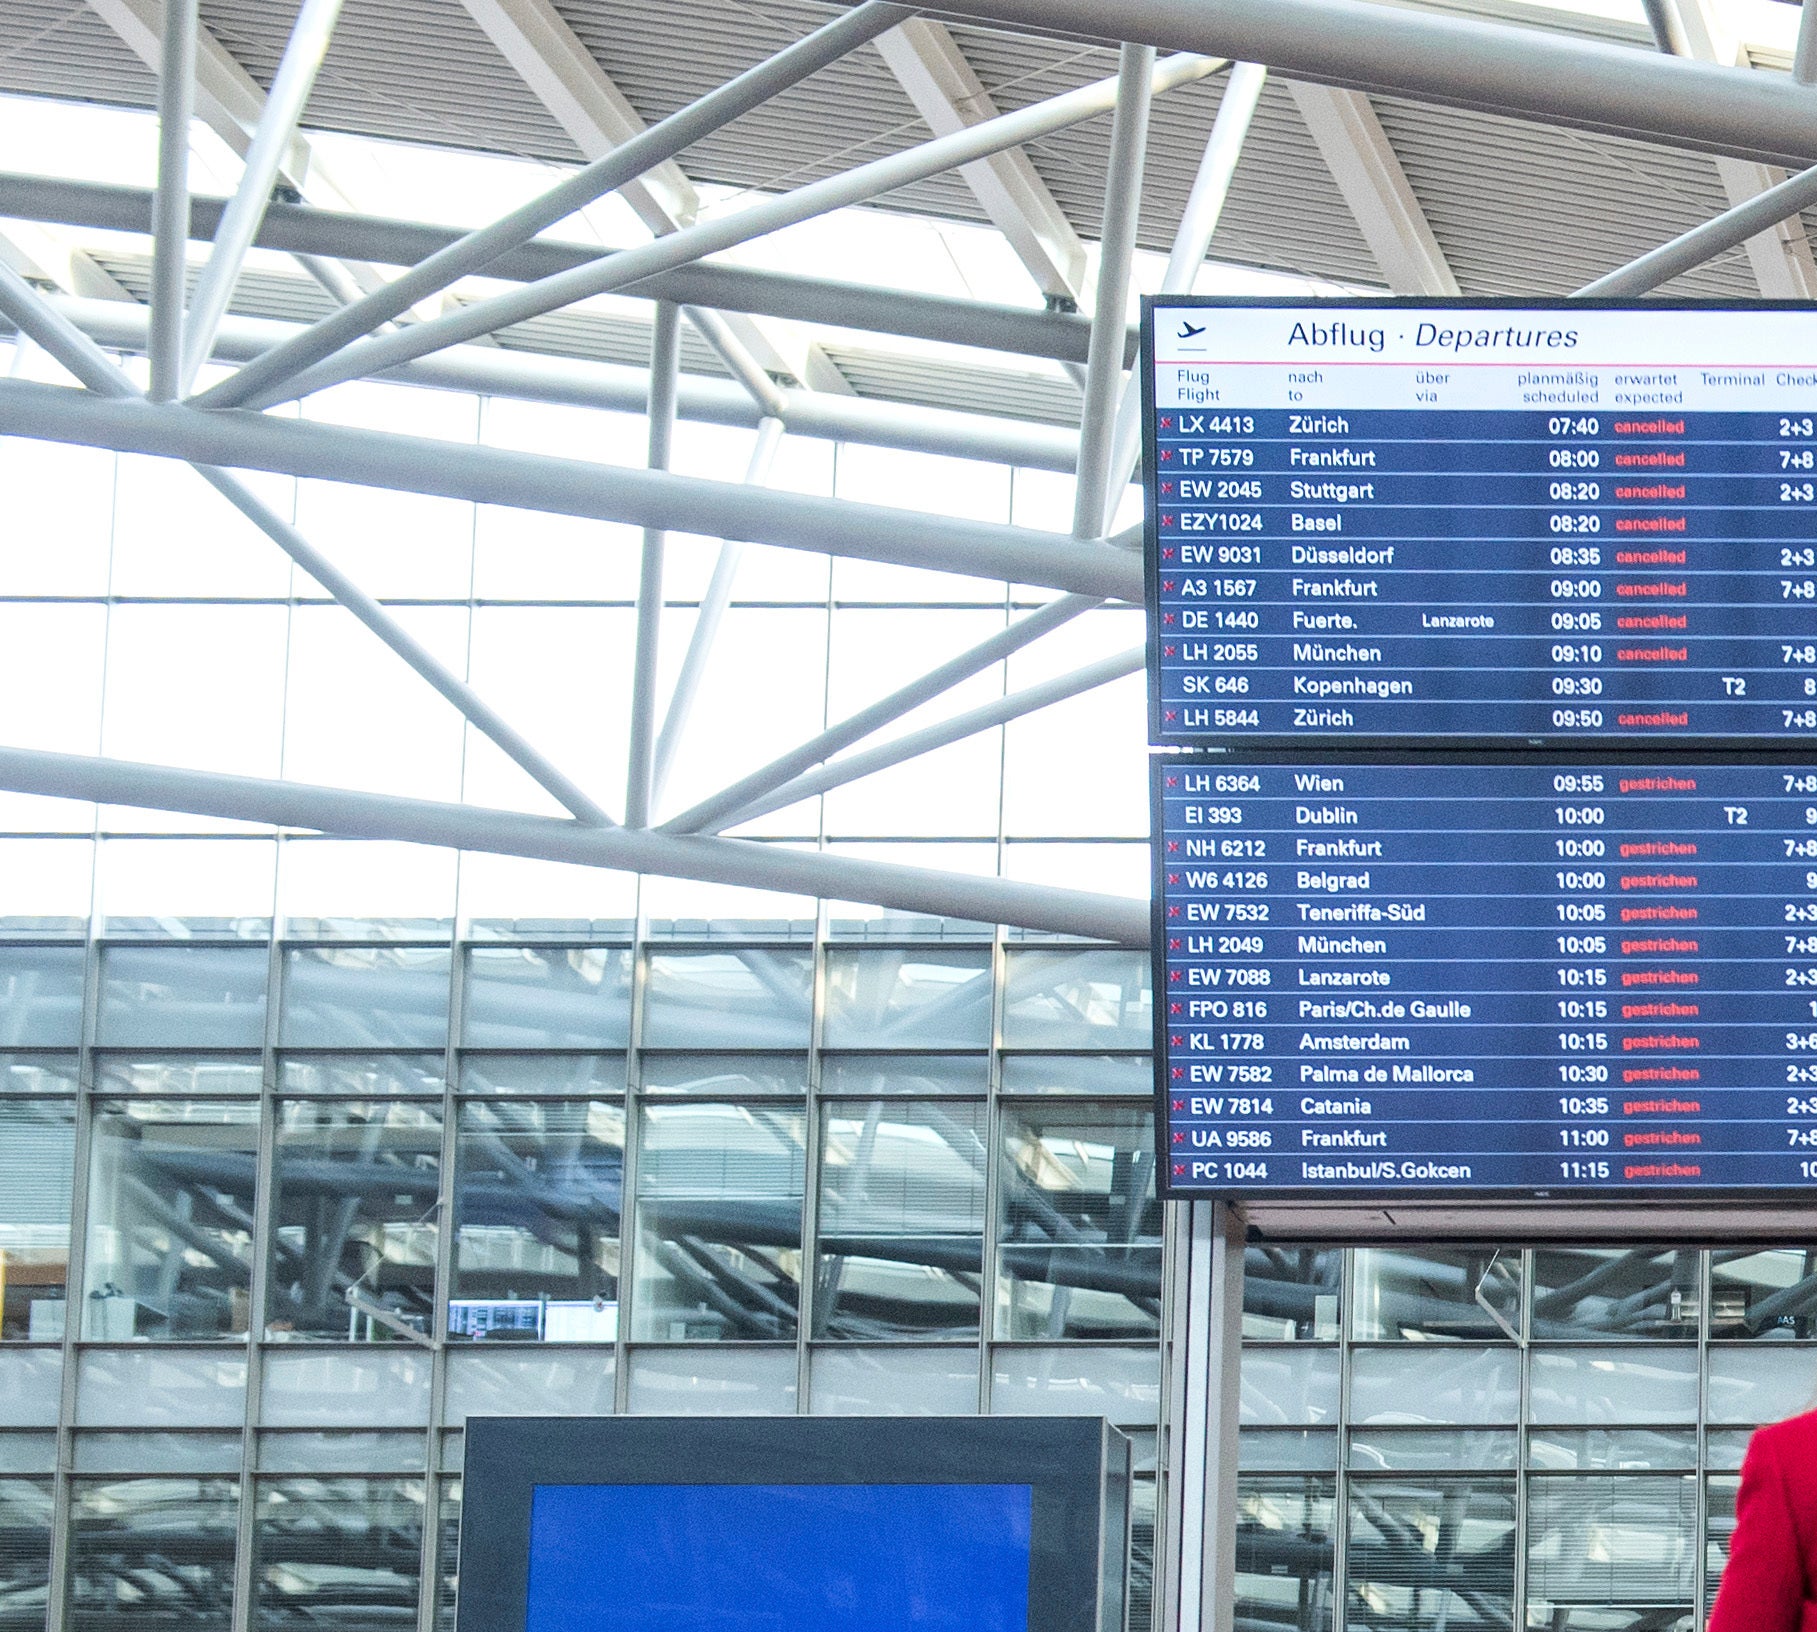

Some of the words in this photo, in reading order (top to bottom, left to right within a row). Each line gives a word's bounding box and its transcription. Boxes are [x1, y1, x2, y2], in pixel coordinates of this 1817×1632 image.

[1288, 323, 1384, 352] Abflug
[1416, 323, 1578, 352] Departures
[1178, 370, 1209, 385] Flug
[1288, 371, 1322, 383] nach
[1416, 372, 1449, 383] über
[1518, 372, 1598, 387] planmäßig
[1615, 374, 1676, 385] erwartet
[1701, 372, 1765, 385] Terminal
[1180, 415, 1204, 432] LX
[1210, 417, 1254, 433] 4413
[1289, 416, 1348, 433] Zürich
[1549, 418, 1599, 434] 07:40
[1615, 422, 1684, 432] cancelled
[1780, 419, 1813, 436] 2+3
[1183, 676, 1210, 693] SK
[1215, 677, 1248, 693] 646
[1294, 676, 1412, 697] Kopenhagen
[1552, 678, 1602, 694] 09:30
[1722, 677, 1745, 695] T2
[1804, 678, 1816, 695] 8
[1186, 806, 1202, 823] EI
[1209, 807, 1241, 823] 393
[1296, 807, 1357, 823] Dublin
[1556, 808, 1604, 824] 10:00
[1724, 807, 1747, 824] T2
[1806, 808, 1817, 824] 9
[1188, 904, 1219, 920] EW
[1225, 904, 1268, 920] 7532
[1297, 904, 1425, 920] Teneriffa-Süd
[1557, 904, 1605, 921] 10:05
[1621, 908, 1696, 920] gestrichen
